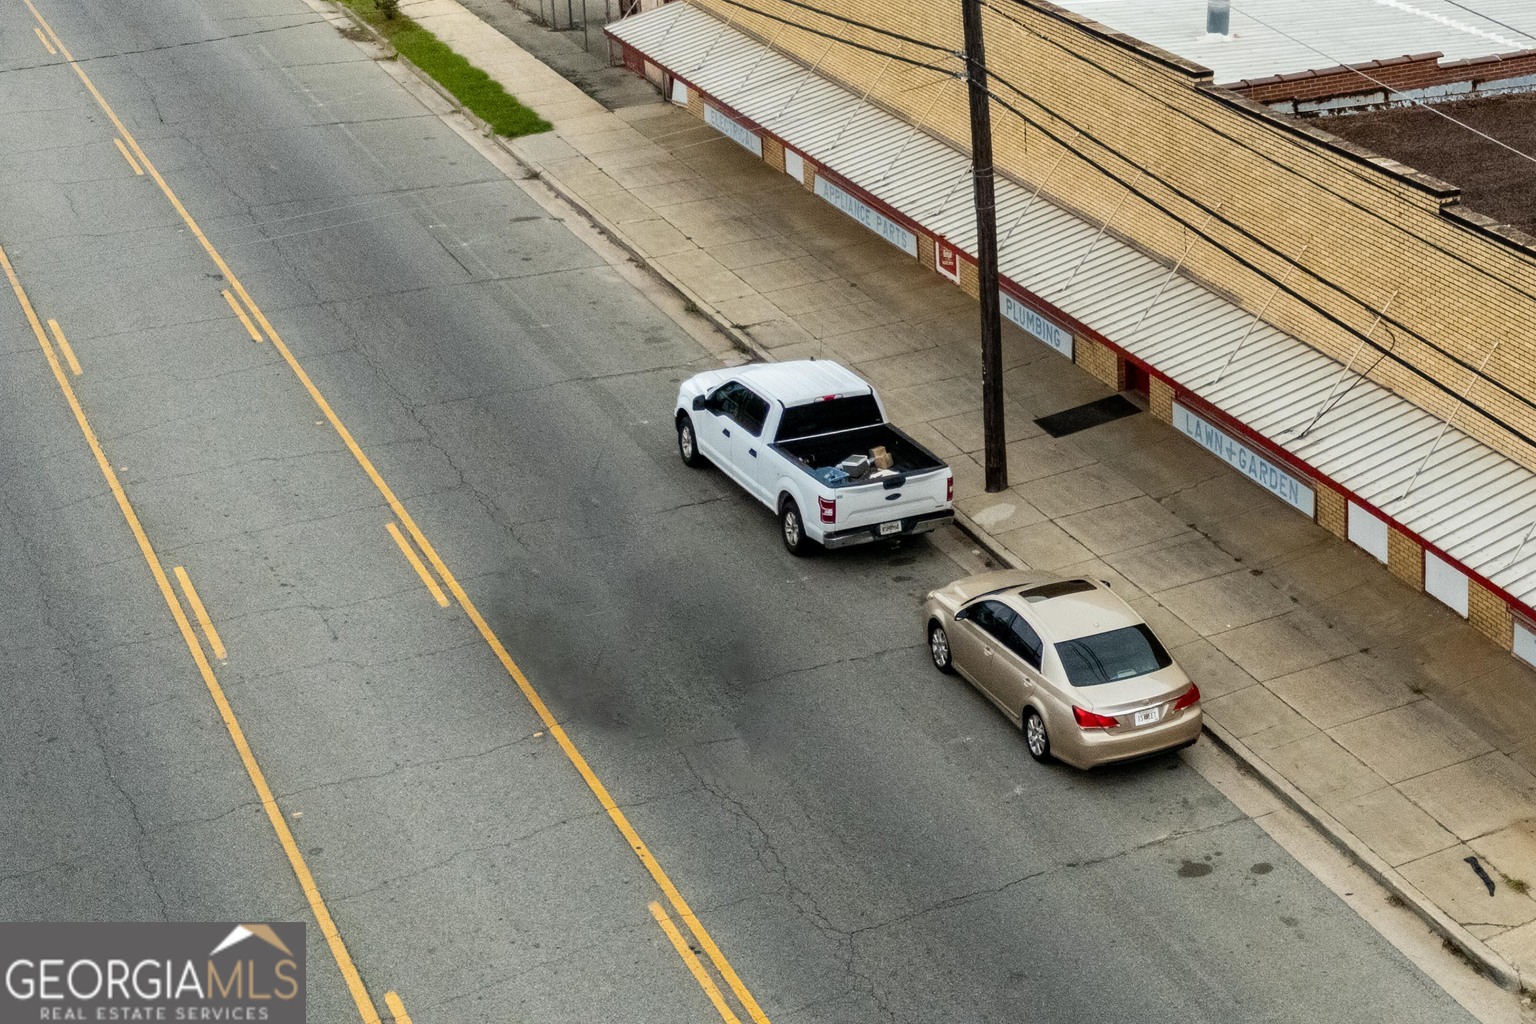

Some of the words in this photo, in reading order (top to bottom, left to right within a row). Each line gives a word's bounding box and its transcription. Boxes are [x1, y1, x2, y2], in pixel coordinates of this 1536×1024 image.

[823, 182, 871, 226] APPLIANCE
[876, 219, 908, 249] PARTS
[1005, 297, 1061, 348] PLUMBING
